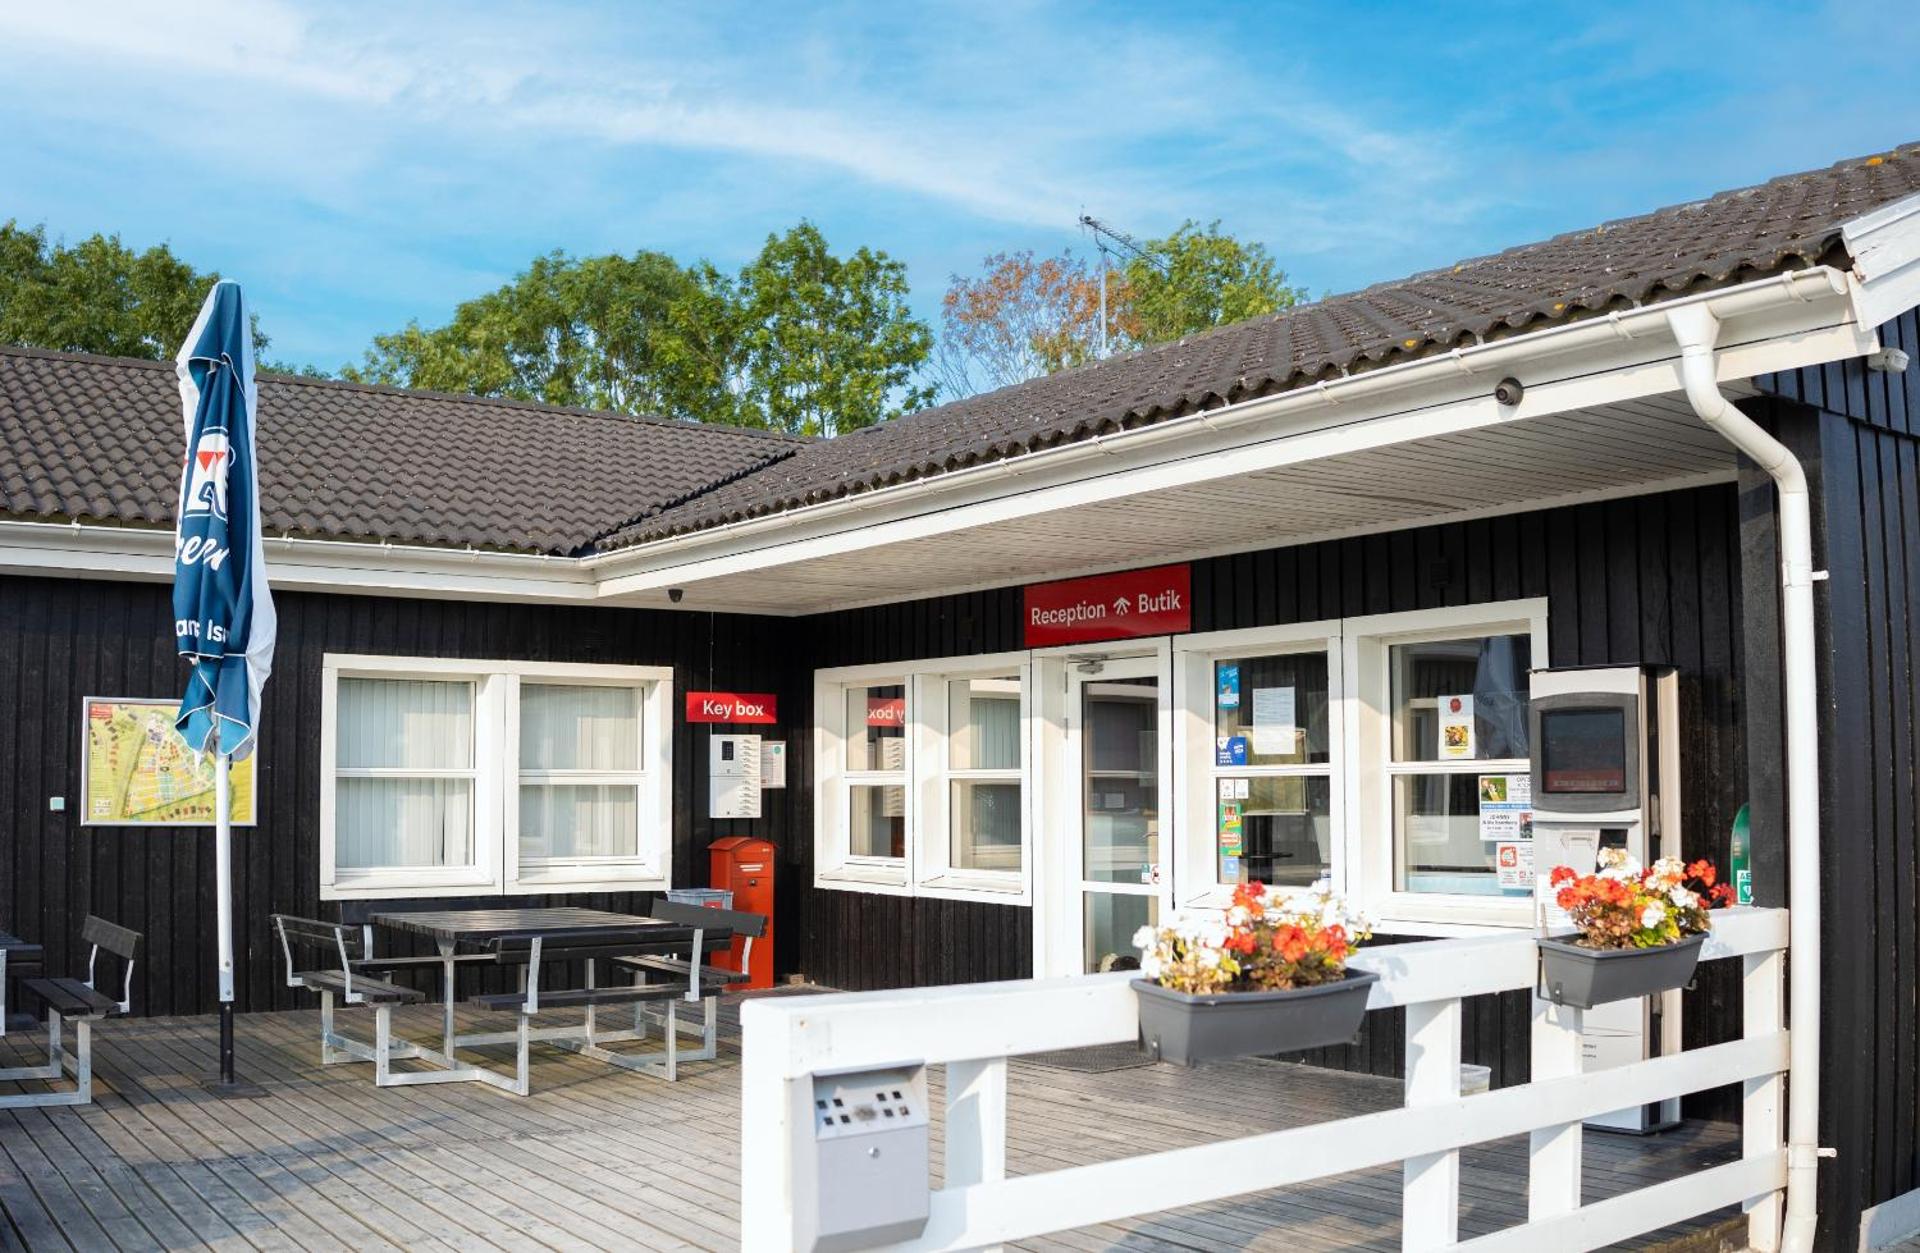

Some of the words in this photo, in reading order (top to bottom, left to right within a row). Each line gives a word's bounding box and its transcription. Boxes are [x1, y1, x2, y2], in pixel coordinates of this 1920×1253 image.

[1031, 601, 1106, 626] Reception
[1138, 589, 1181, 614] Butik
[703, 700, 732, 719] Key
[735, 701, 764, 716] box
